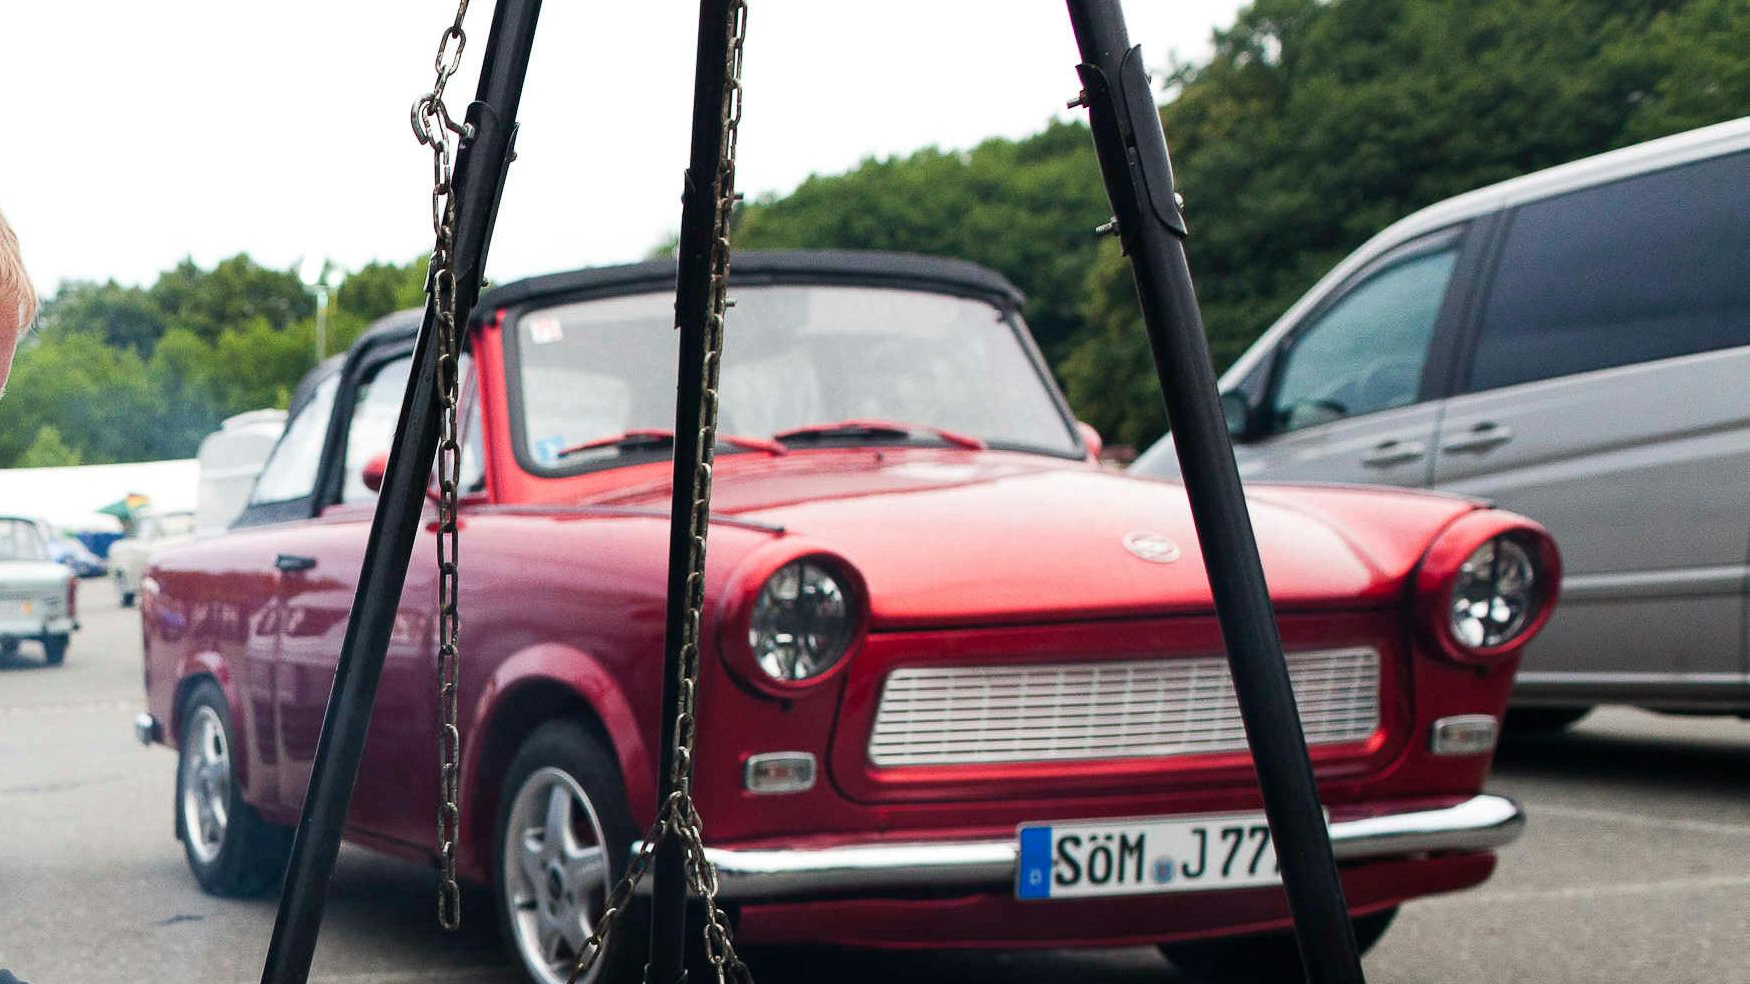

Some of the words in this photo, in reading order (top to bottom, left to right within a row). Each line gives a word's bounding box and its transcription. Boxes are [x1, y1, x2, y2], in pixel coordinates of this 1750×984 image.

[1055, 831, 1146, 886] SÖM
[1181, 828, 1208, 879] J
[1220, 825, 1282, 877] 77
